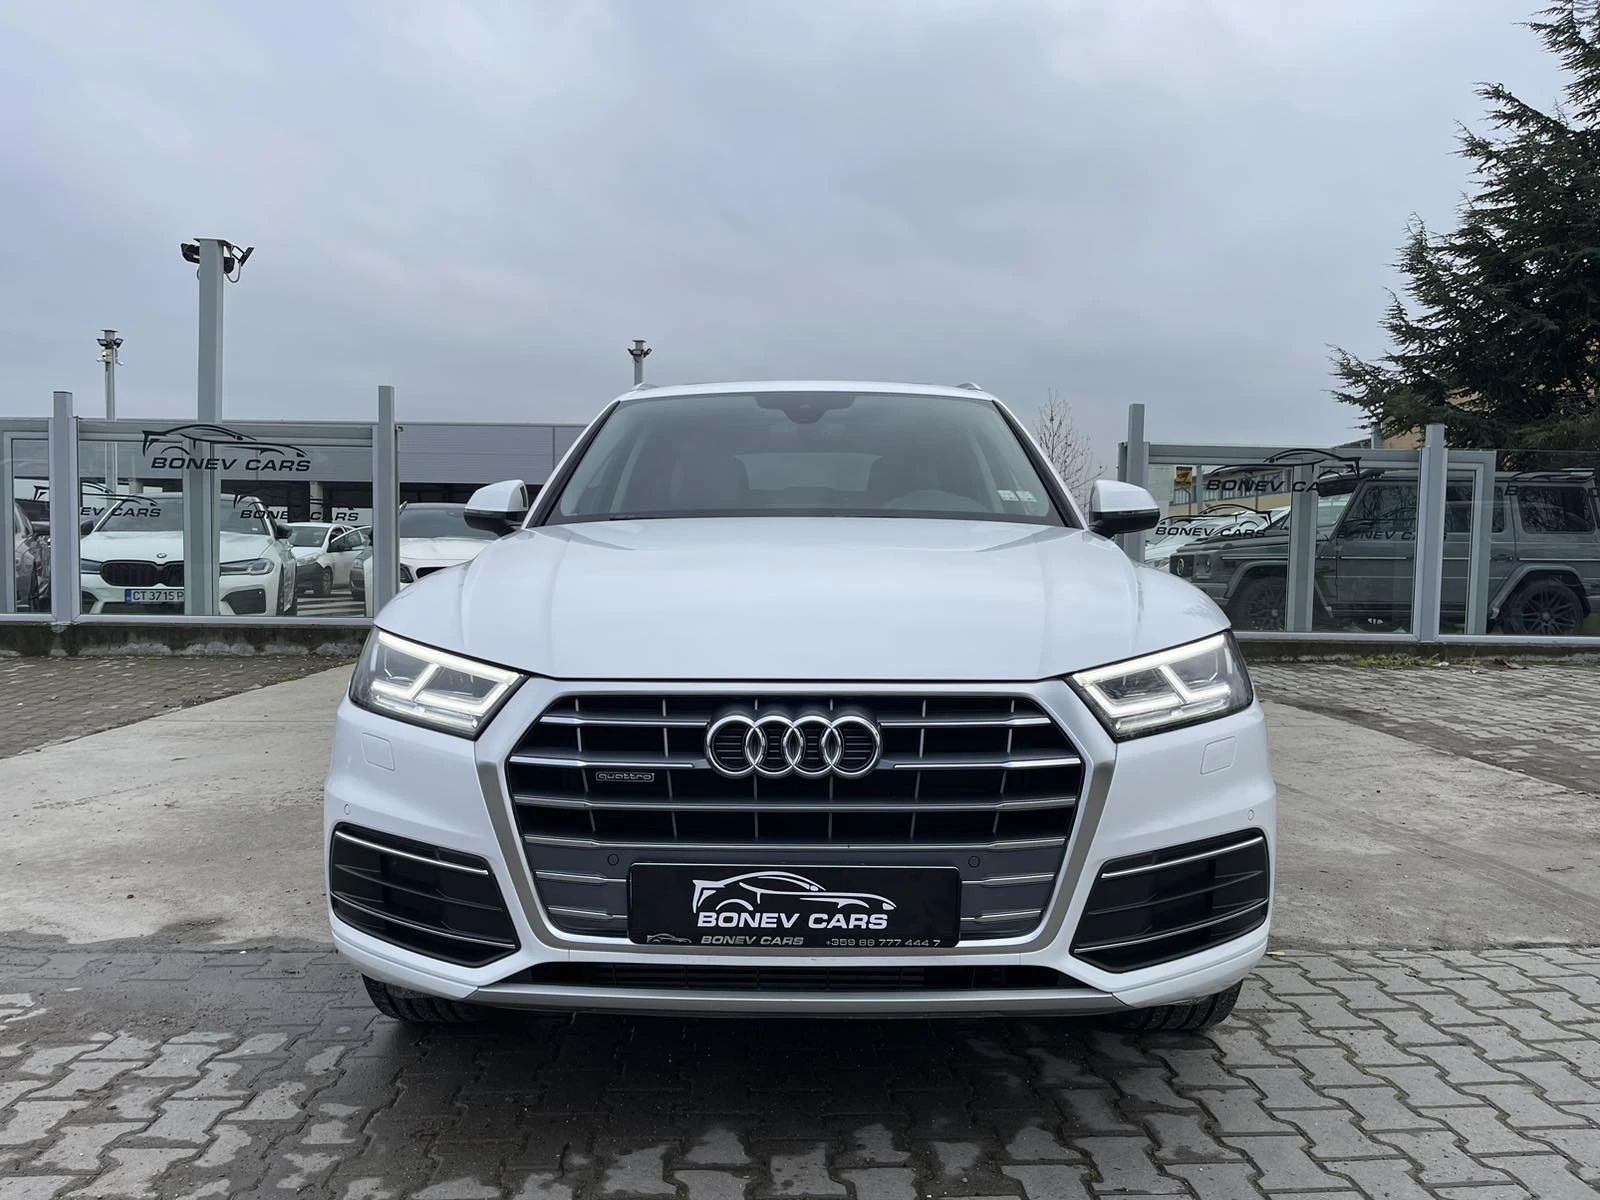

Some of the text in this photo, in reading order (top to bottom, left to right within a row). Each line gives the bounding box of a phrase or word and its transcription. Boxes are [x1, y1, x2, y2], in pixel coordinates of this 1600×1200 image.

[151, 457, 311, 472] BONEV CARS
[1206, 479, 1284, 492] BONEV
[111, 507, 161, 517] CARS
[1155, 527, 1267, 537] BONEV CARS
[132, 592, 146, 601] CT
[151, 592, 175, 601] 3715
[697, 911, 888, 930] BONEV CARS
[700, 935, 757, 945] BONEV
[760, 936, 804, 946] CARS
[825, 938, 856, 946] +359
[859, 938, 876, 947] 88
[879, 938, 902, 947] 777
[905, 939, 929, 947] 444
